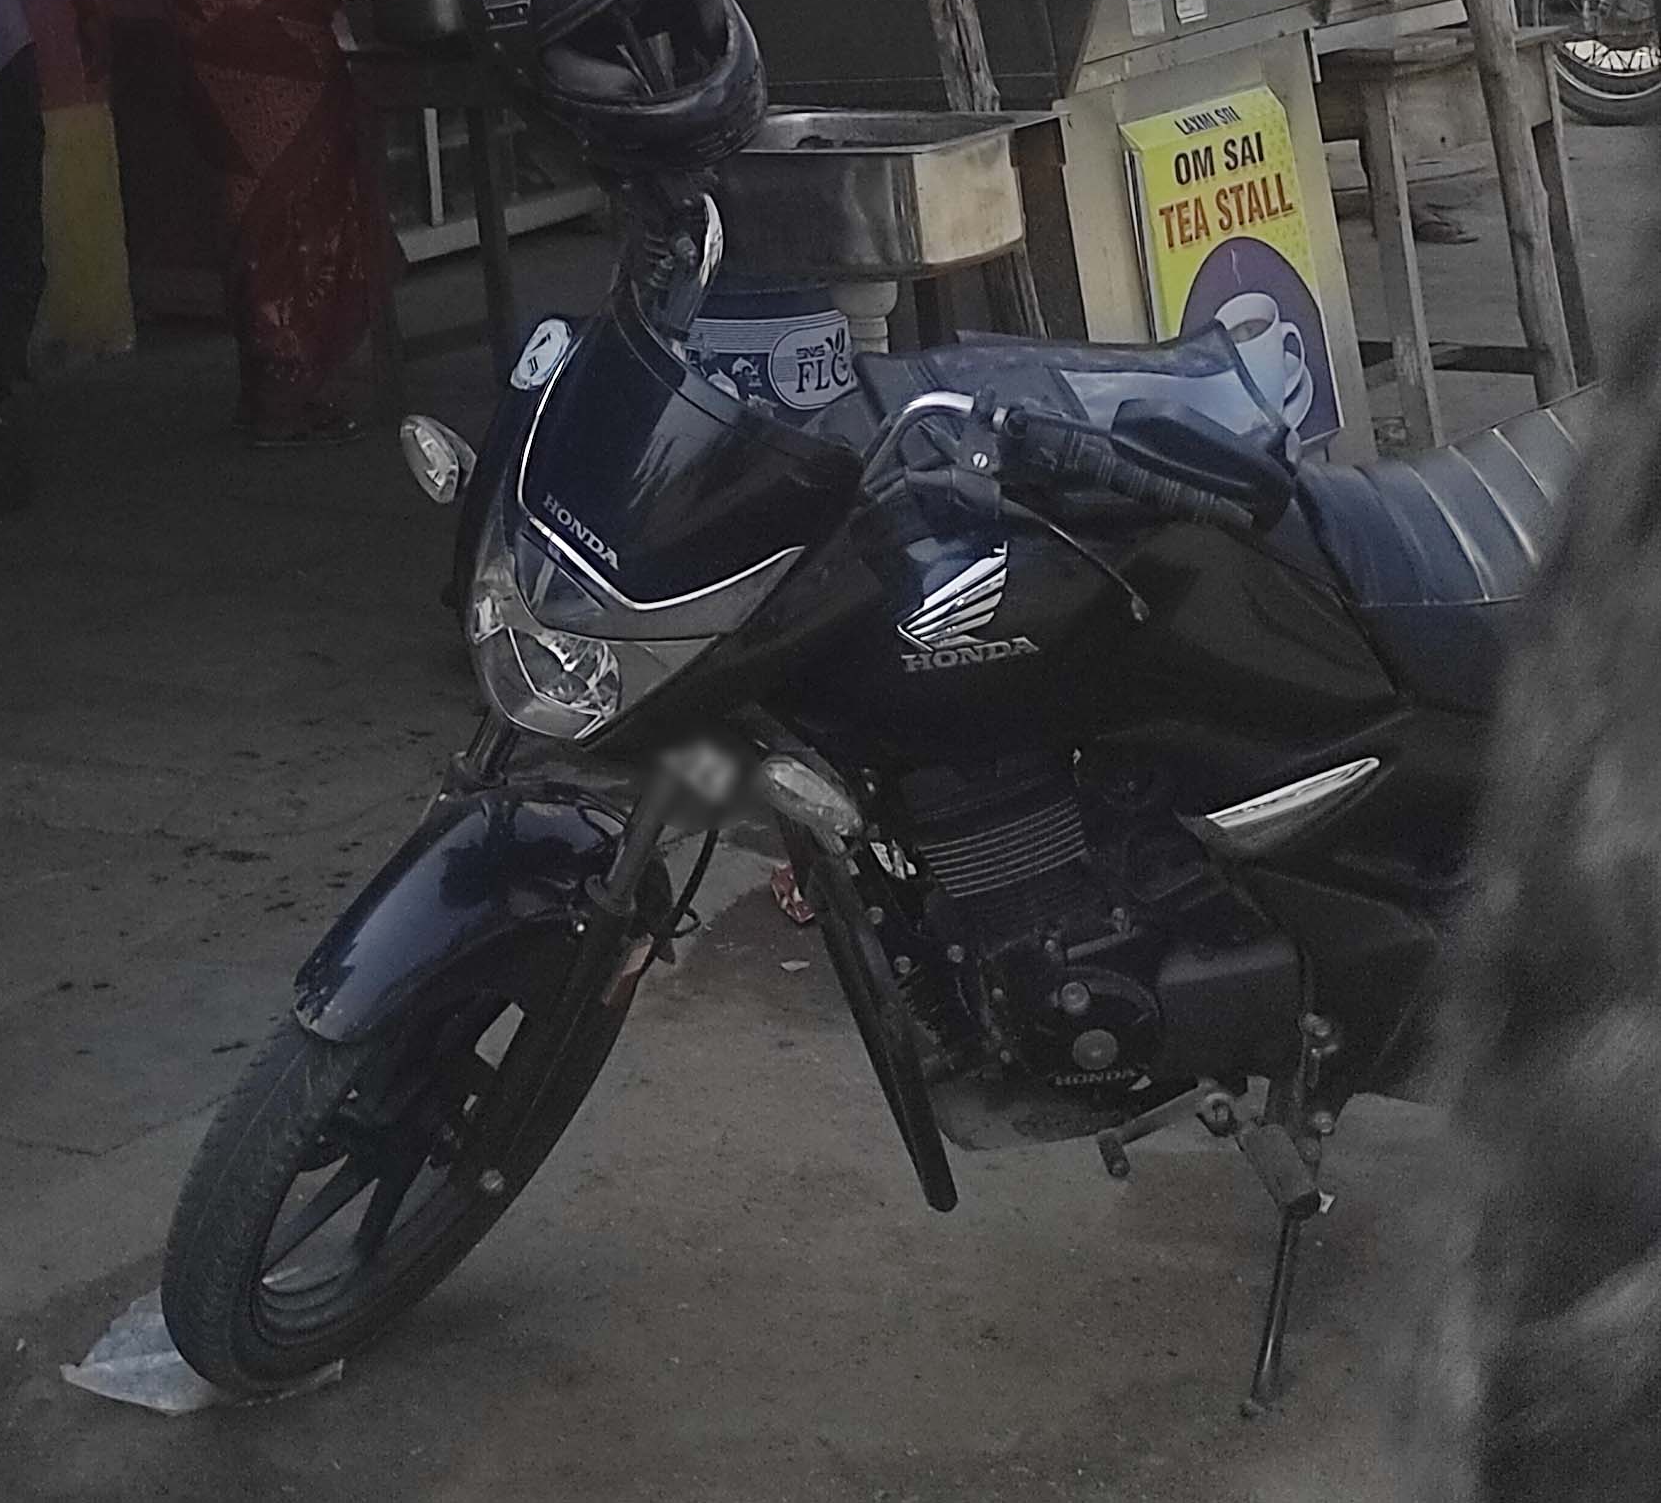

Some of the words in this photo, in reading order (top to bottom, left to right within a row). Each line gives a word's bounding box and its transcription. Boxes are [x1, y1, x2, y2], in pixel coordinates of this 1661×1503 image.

[1174, 109, 1216, 136] LAXMI
[1173, 144, 1216, 186] OM
[1224, 130, 1265, 173] SAI
[1158, 195, 1210, 250] TEA
[1215, 172, 1295, 233] STALL
[543, 493, 620, 571] HONDA
[901, 637, 1039, 673] HONDA
